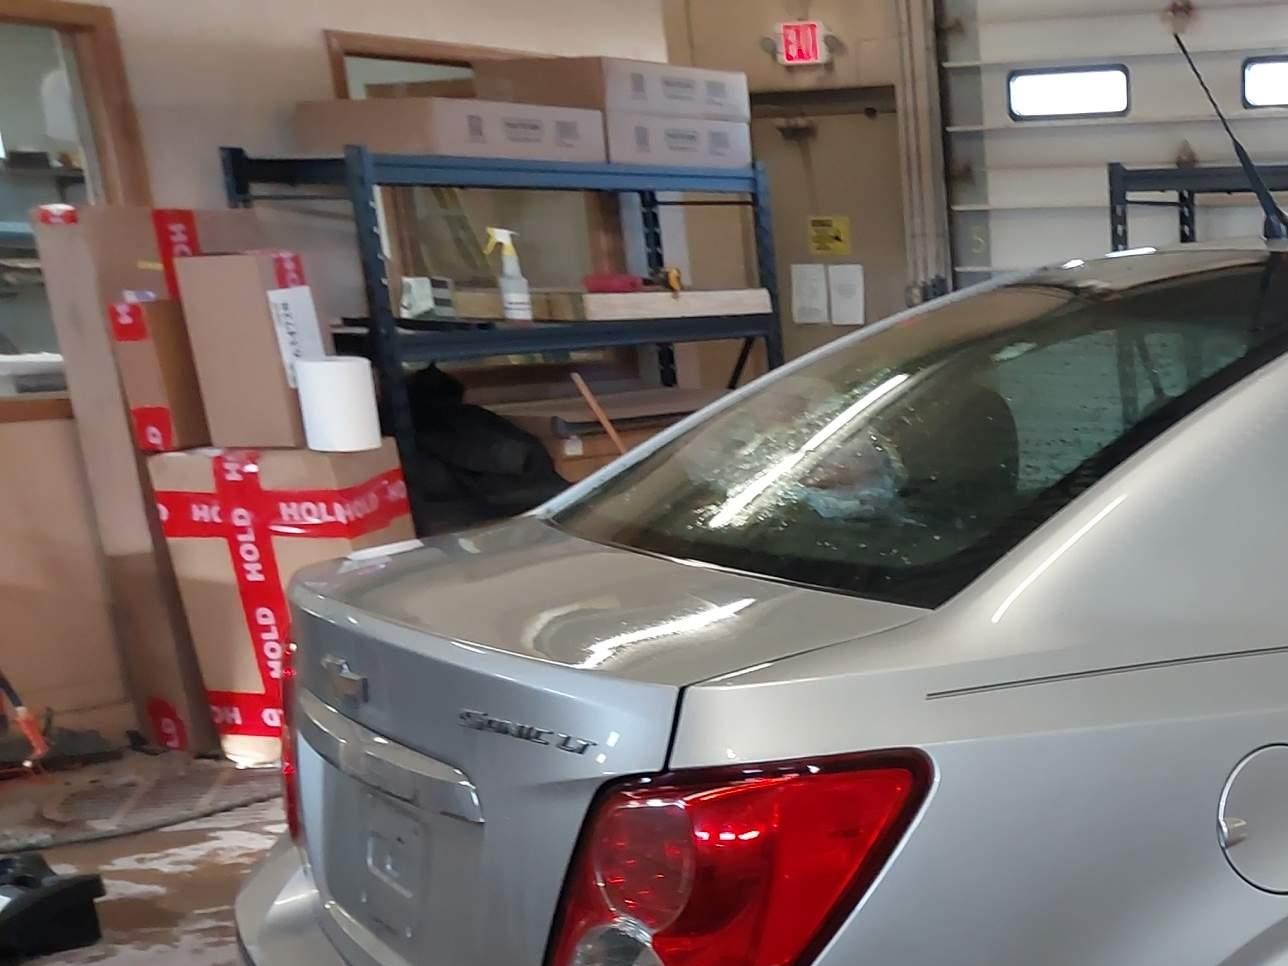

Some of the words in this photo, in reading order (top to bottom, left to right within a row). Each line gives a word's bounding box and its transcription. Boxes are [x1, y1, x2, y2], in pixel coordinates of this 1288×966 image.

[231, 507, 265, 582] HOLD
[256, 607, 283, 679] HOLD
[556, 733, 598, 755] LT
